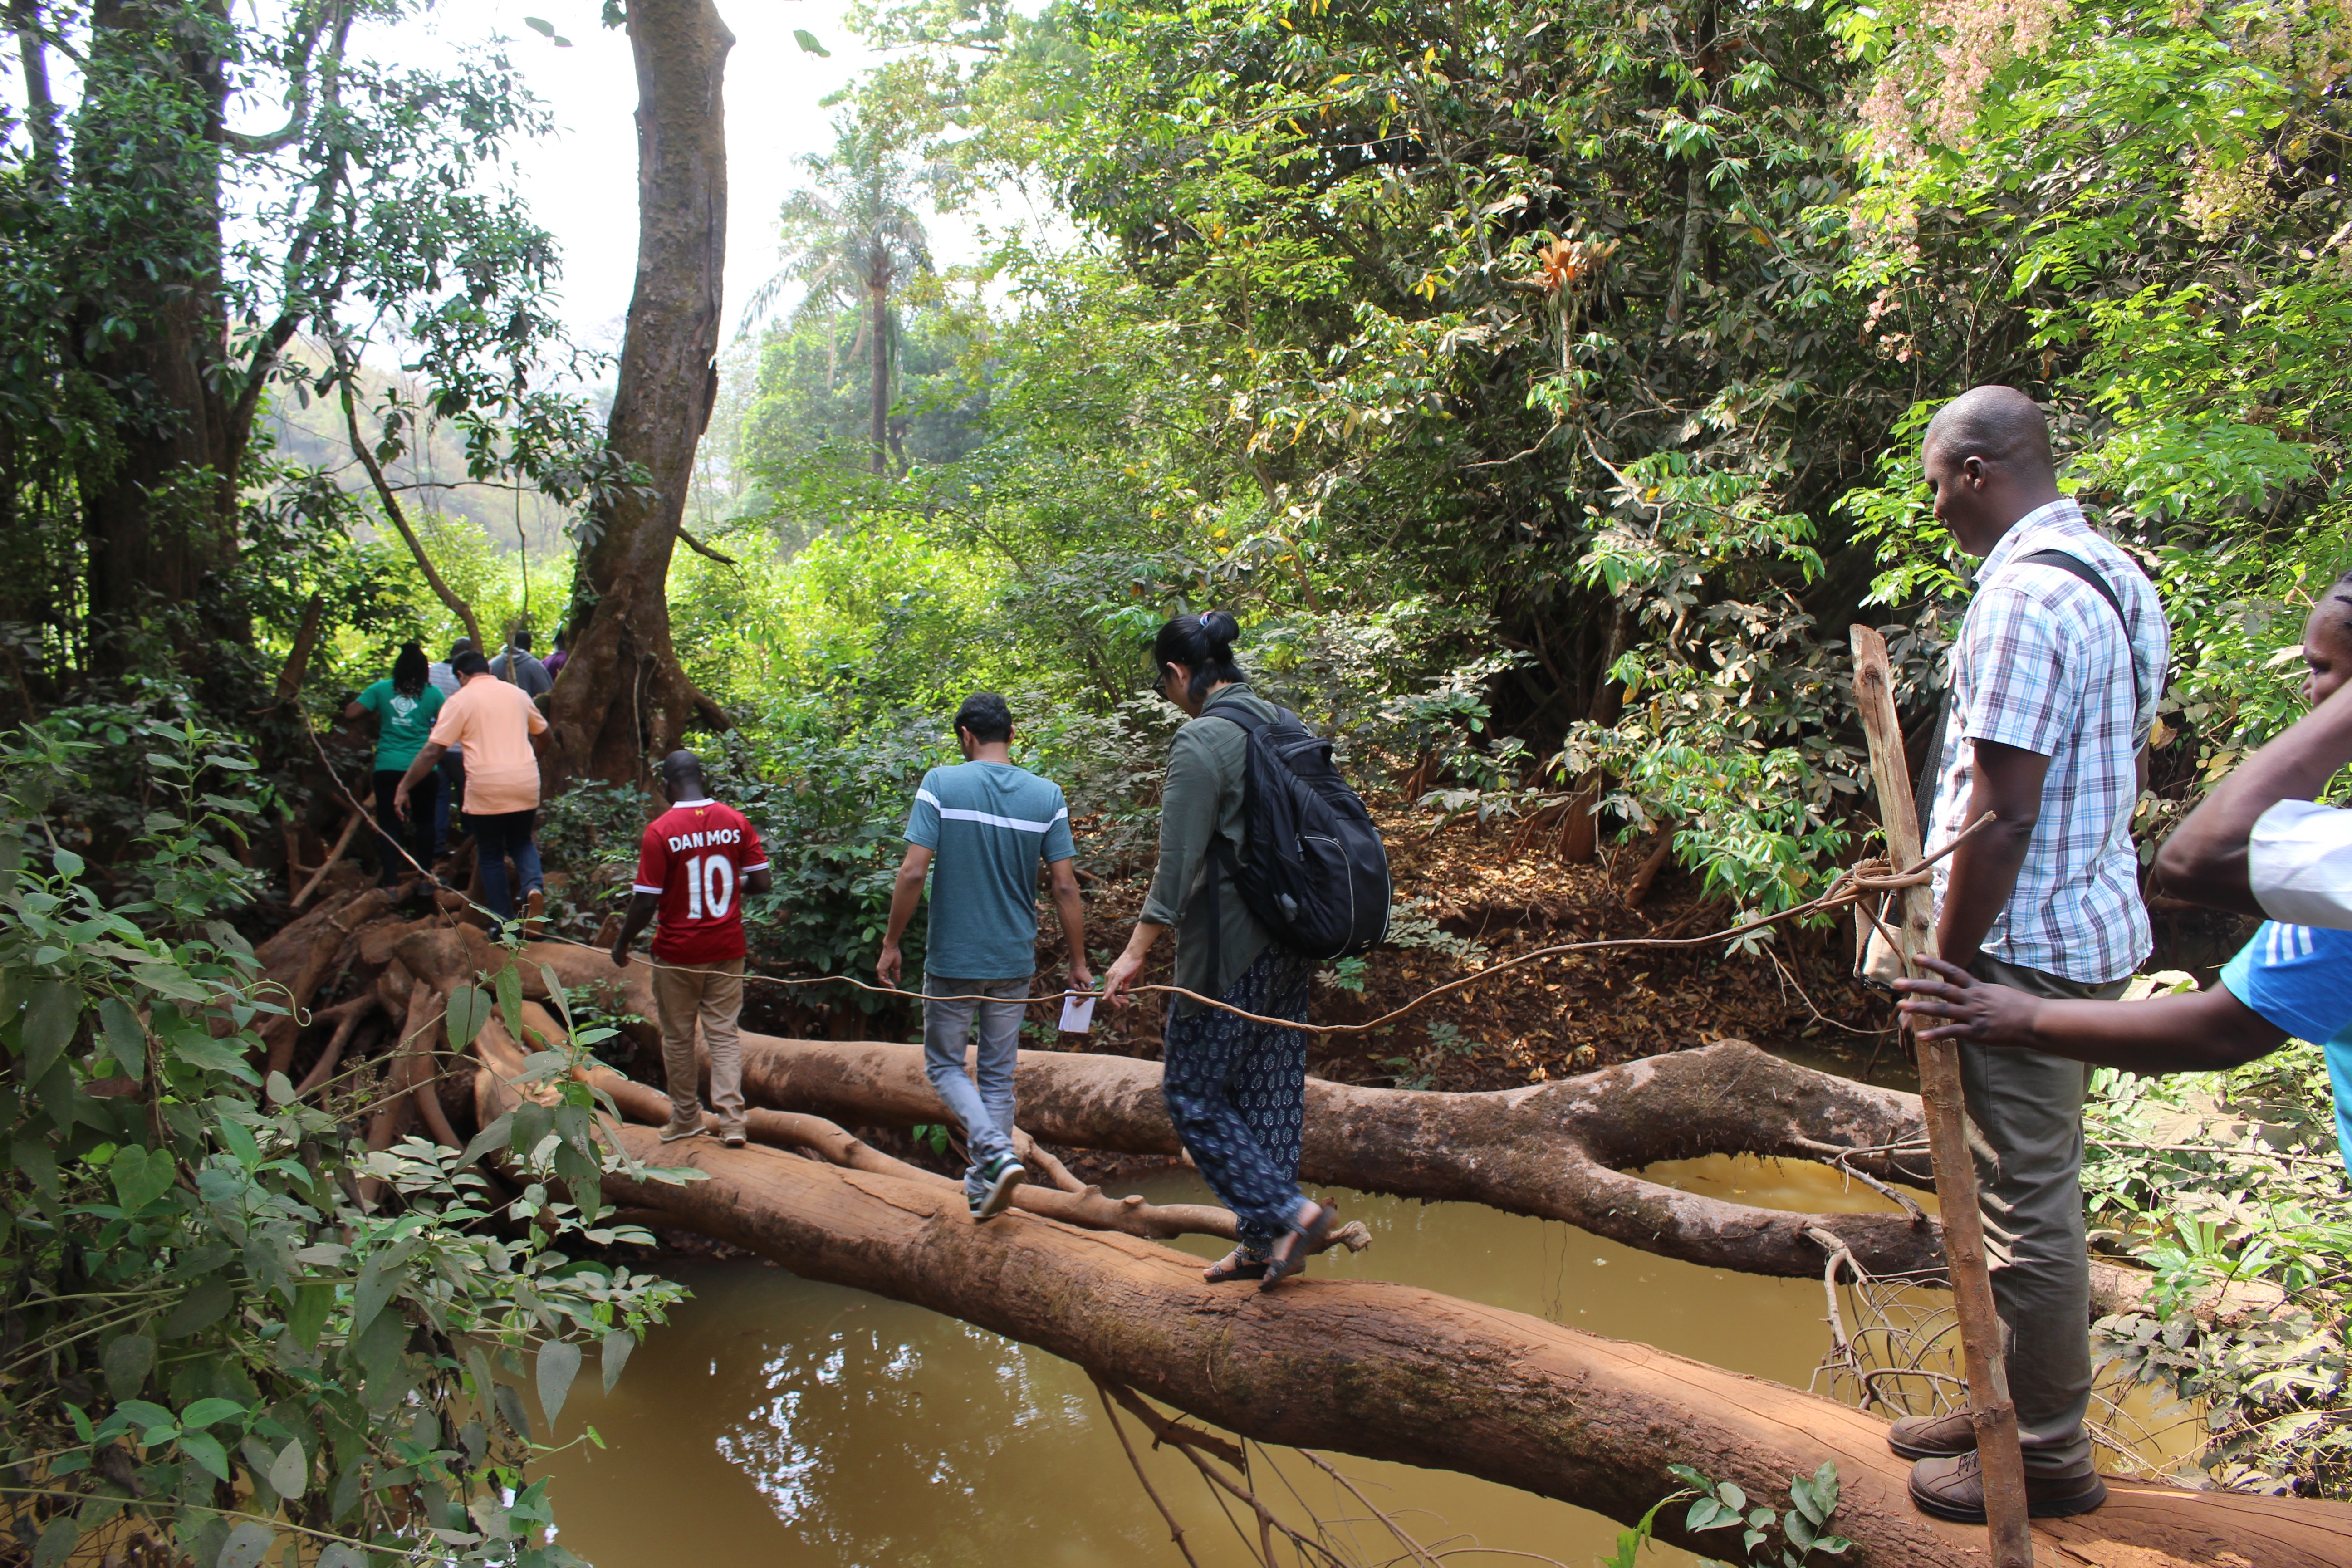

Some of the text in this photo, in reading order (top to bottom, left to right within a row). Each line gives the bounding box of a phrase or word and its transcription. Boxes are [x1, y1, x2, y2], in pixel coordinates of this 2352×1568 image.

[668, 828, 741, 853] DAN MOS
[686, 854, 734, 919] 10
